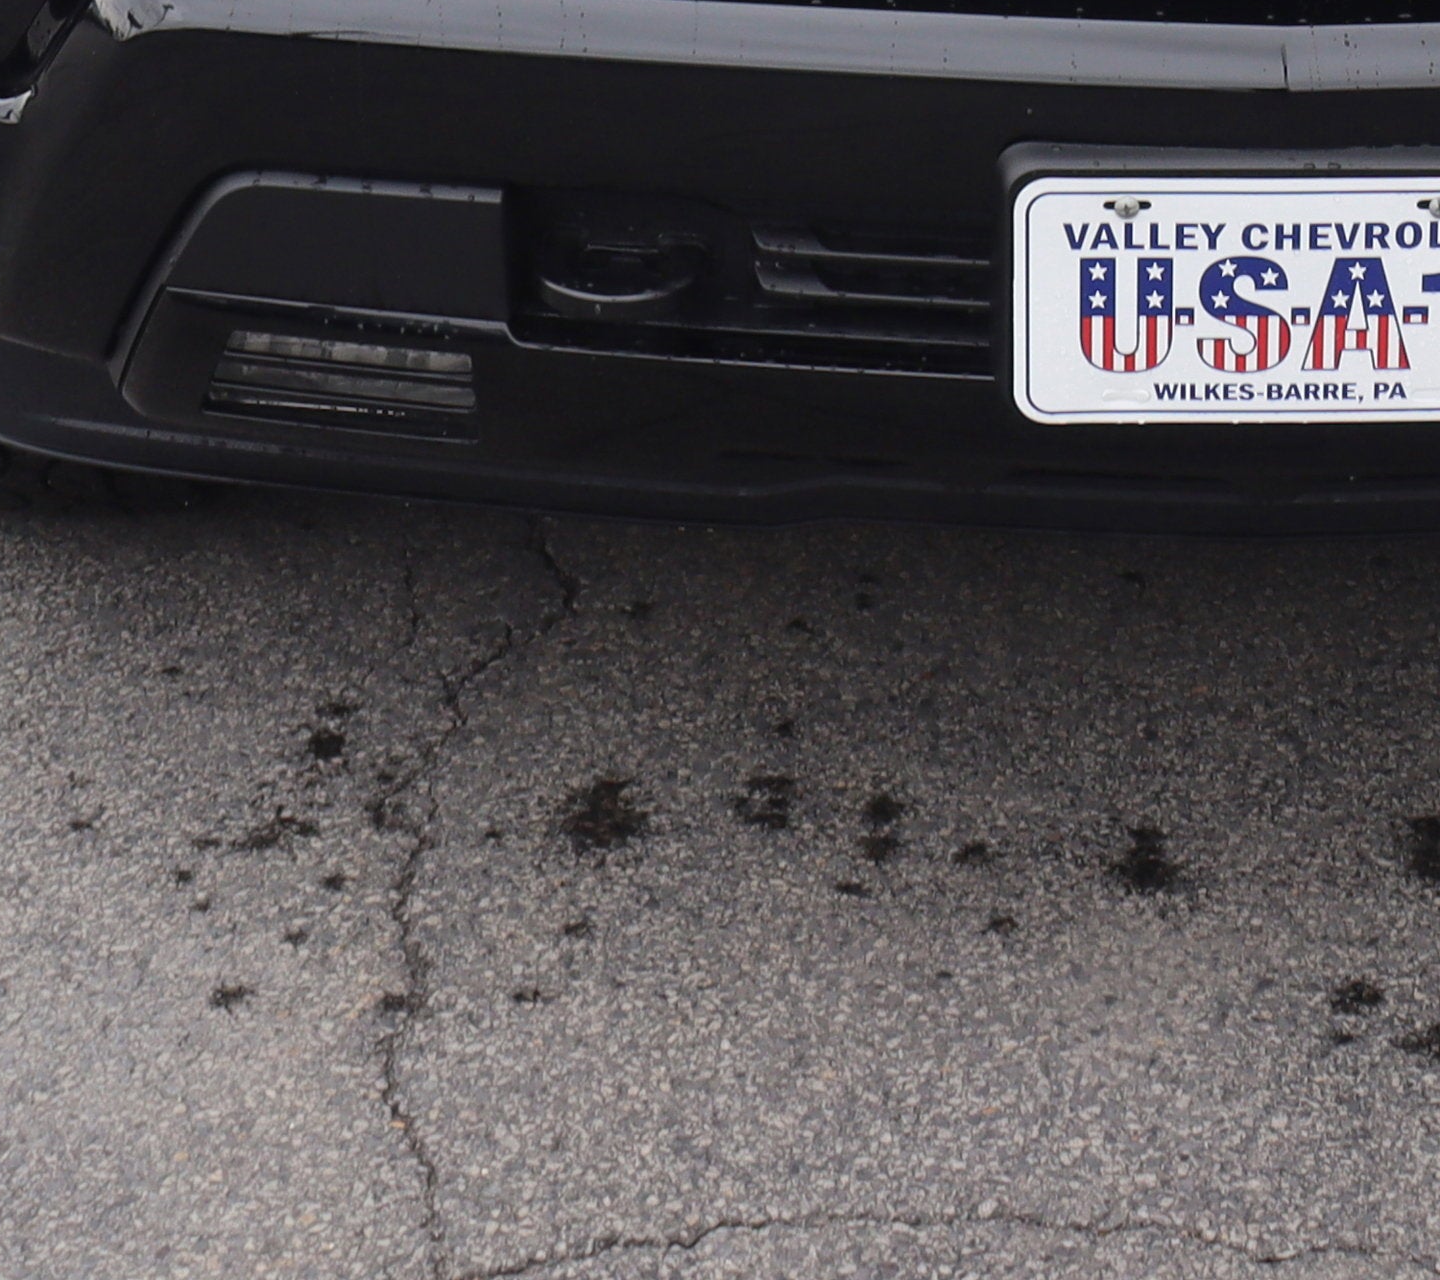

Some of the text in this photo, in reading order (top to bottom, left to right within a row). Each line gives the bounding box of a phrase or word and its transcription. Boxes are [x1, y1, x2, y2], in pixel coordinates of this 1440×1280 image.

[1063, 222, 1227, 251] VALLEY
[1153, 382, 1407, 405] WILKES-BARRE, PA
